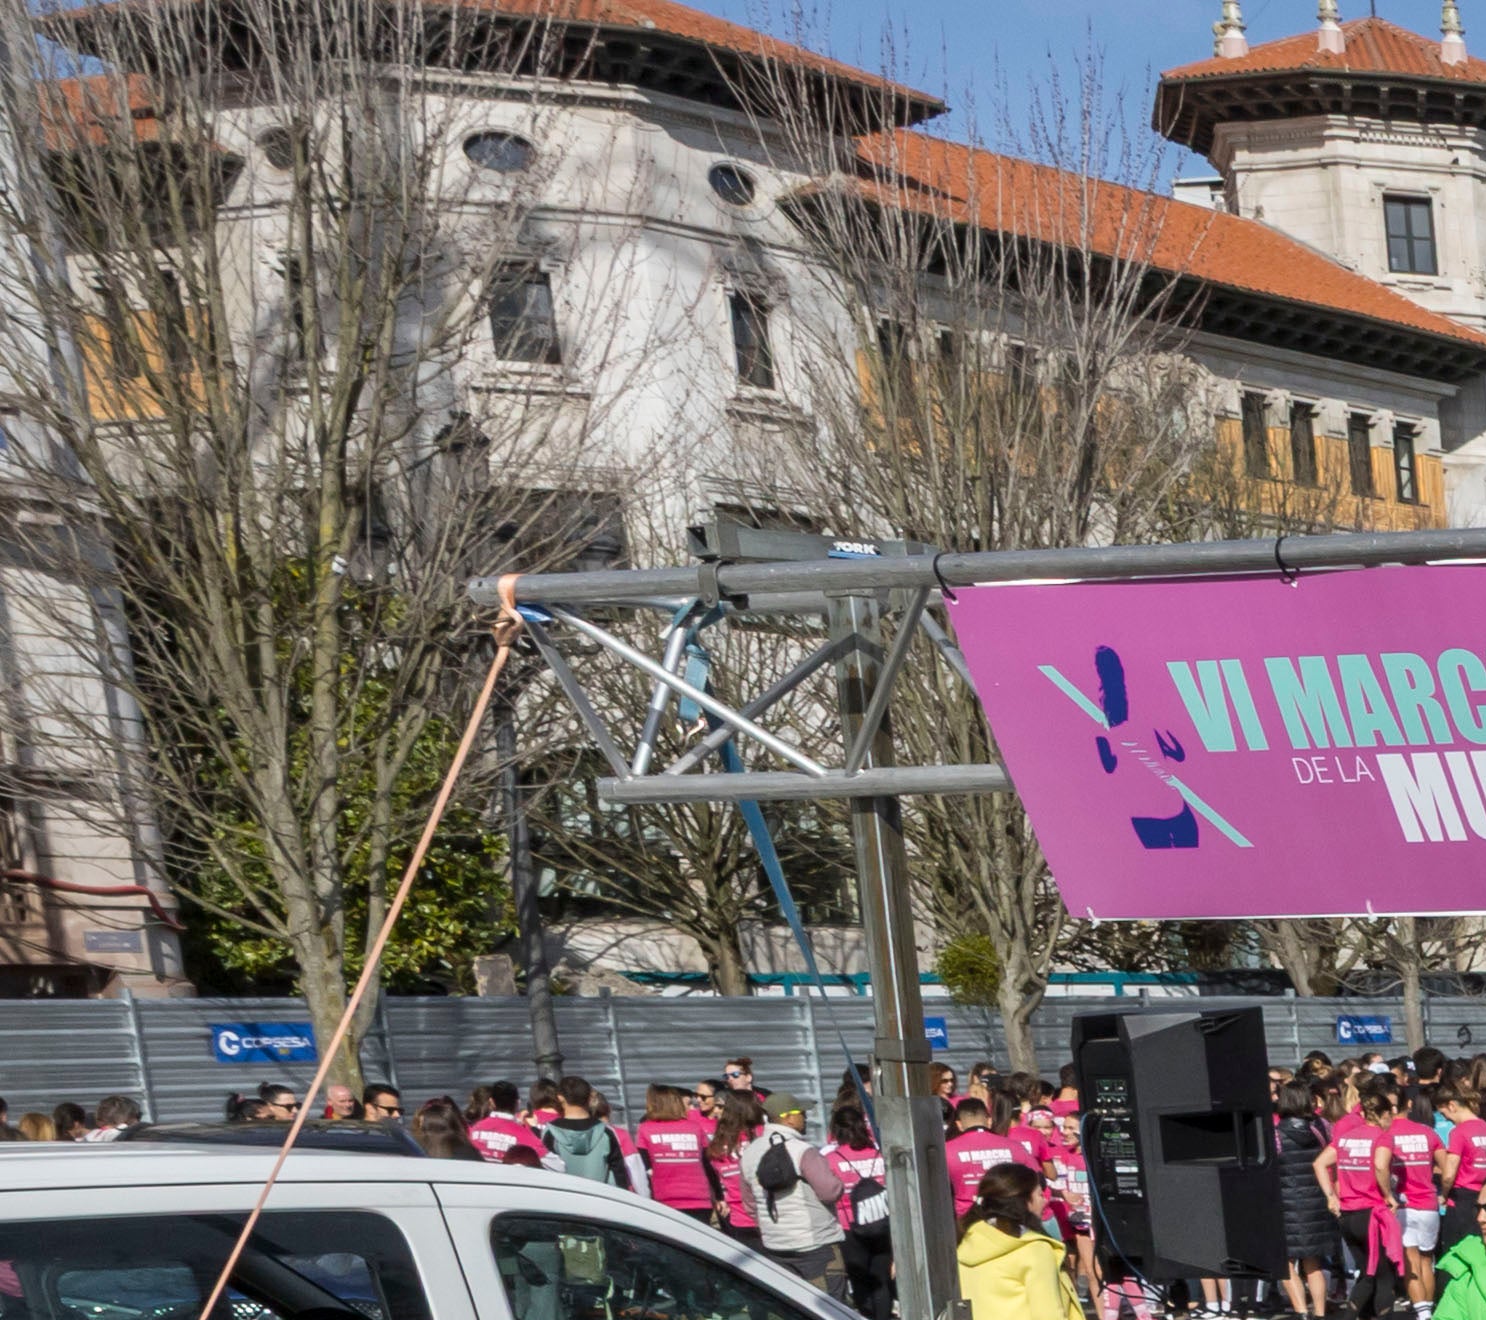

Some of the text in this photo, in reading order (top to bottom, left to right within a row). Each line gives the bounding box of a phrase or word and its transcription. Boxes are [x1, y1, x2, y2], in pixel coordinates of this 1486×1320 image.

[1166, 659, 1269, 752] VI
[1292, 755, 1376, 785] DE LA
